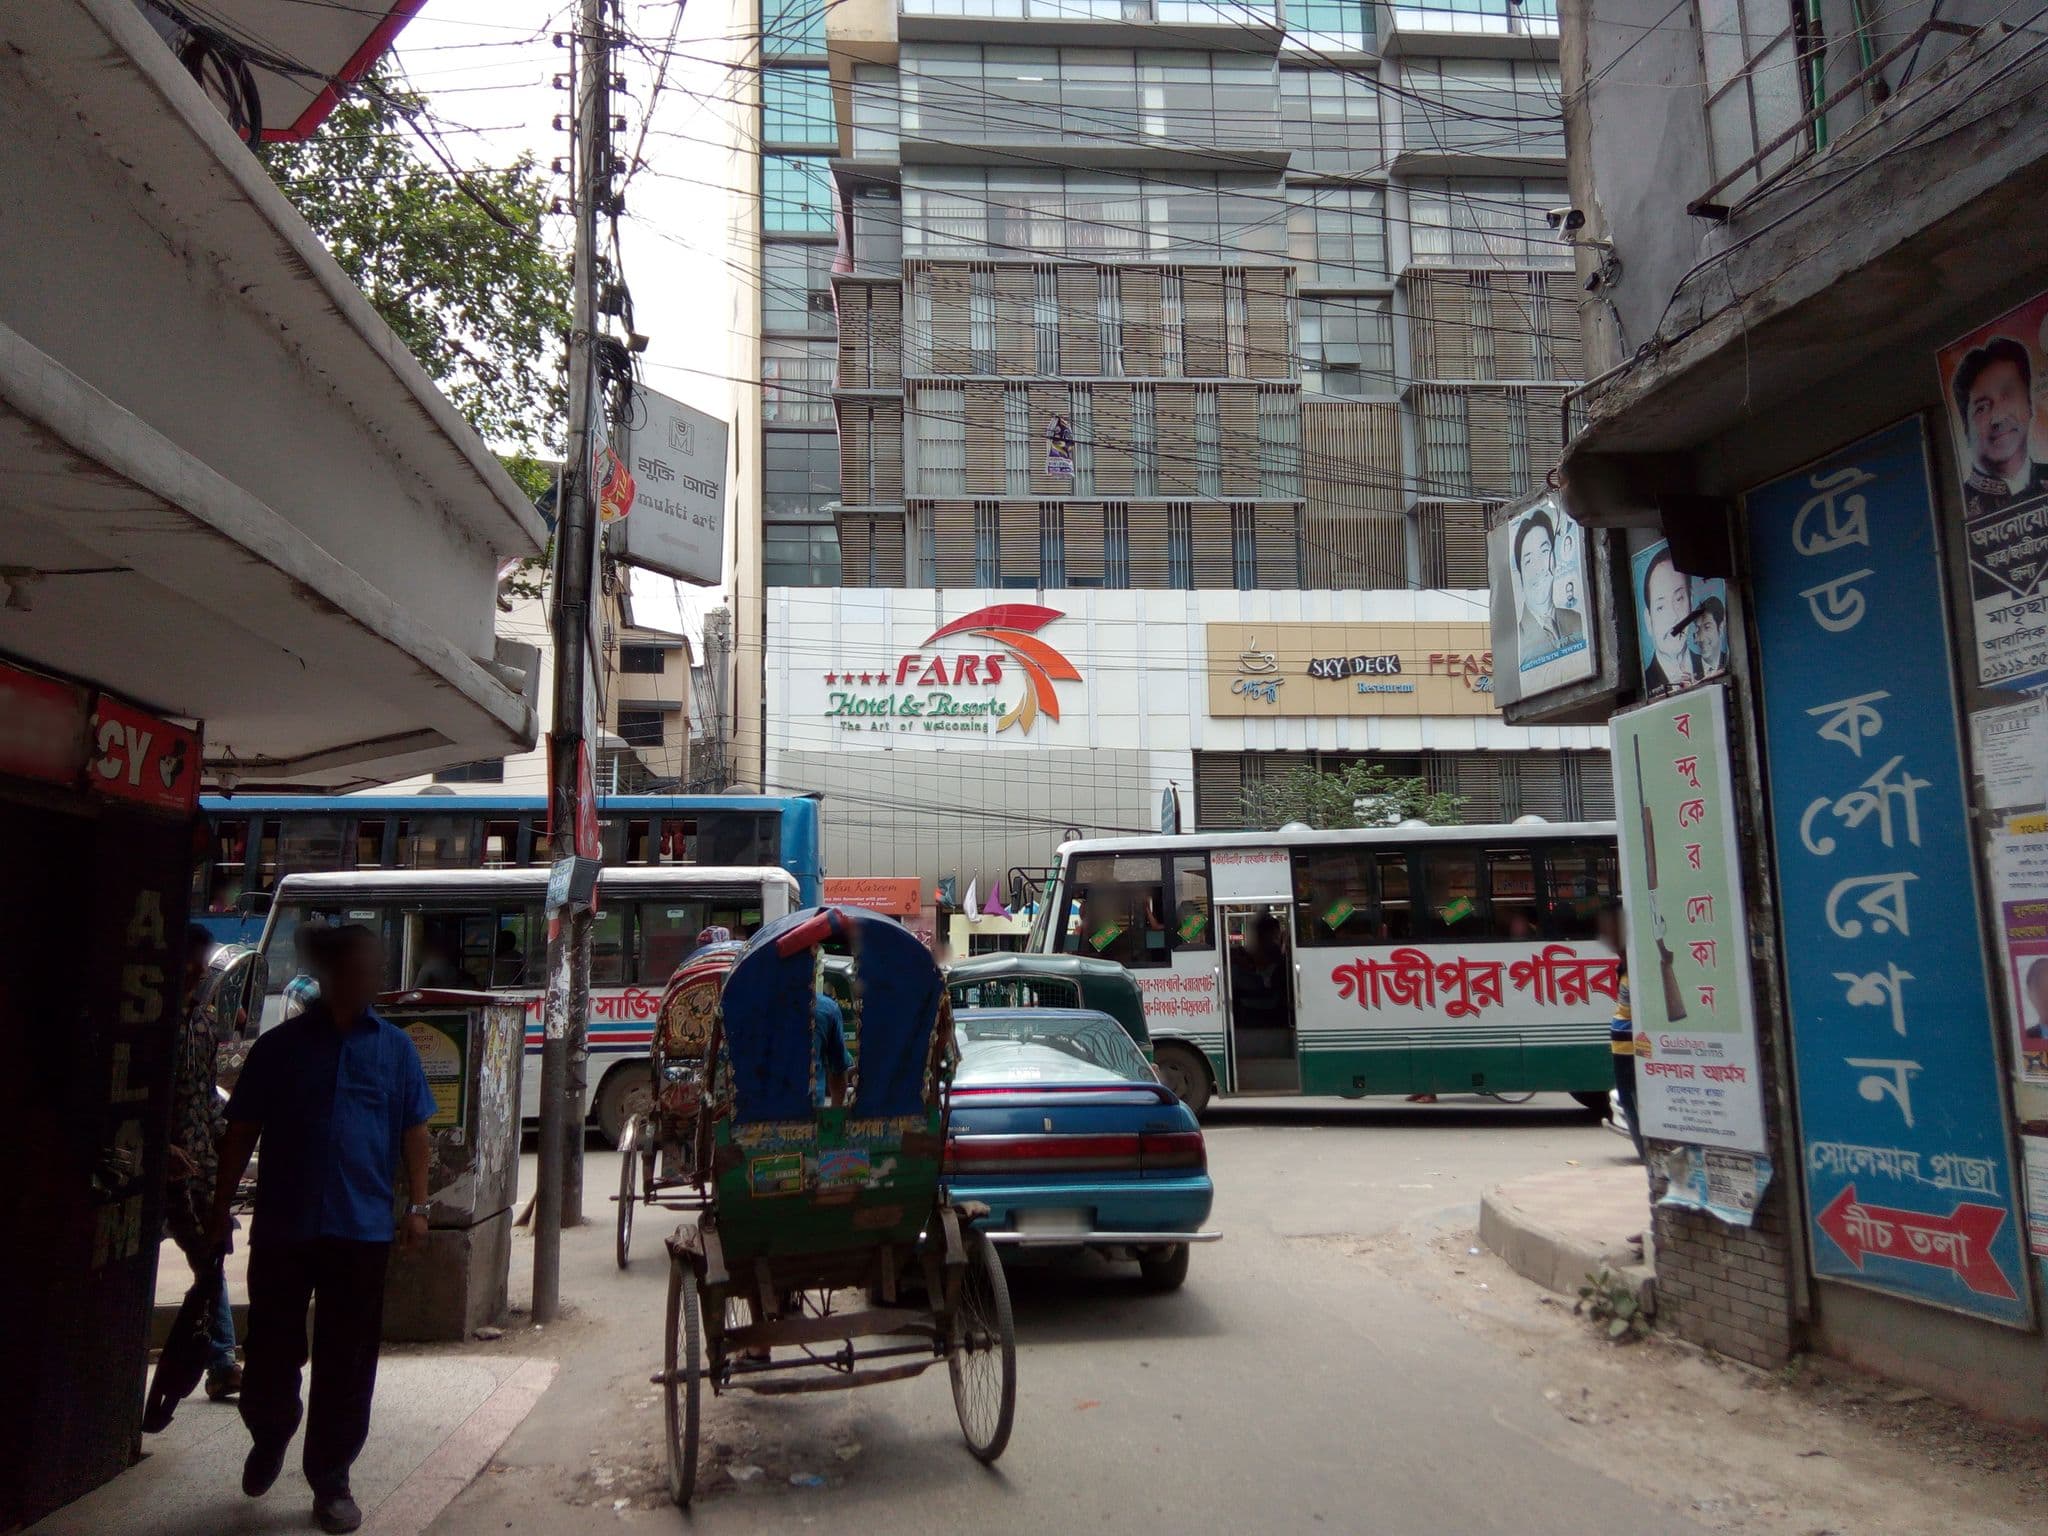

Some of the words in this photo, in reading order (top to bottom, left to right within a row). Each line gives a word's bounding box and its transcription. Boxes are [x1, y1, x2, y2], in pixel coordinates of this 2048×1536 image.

[638, 492, 688, 521] mukti
[692, 511, 717, 532] art
[895, 655, 1005, 685] FARS
[1313, 658, 1343, 677] SKY
[1355, 655, 1398, 674] DECK
[824, 692, 896, 716] Hotel
[899, 694, 925, 716] &
[927, 692, 1006, 716] Resorts
[840, 721, 861, 732] The
[870, 721, 889, 731] Art
[900, 721, 914, 731] of
[923, 721, 989, 733] Welcoming
[1332, 948, 1506, 1019] গাজীপুর
[1659, 1035, 1706, 1049] Gulshan
[1645, 1062, 1696, 1080] গুলশান
[1810, 1141, 1920, 1182] সোলেমান
[1841, 1204, 1894, 1249] নীচ
[1901, 1225, 1971, 1269] তলা
